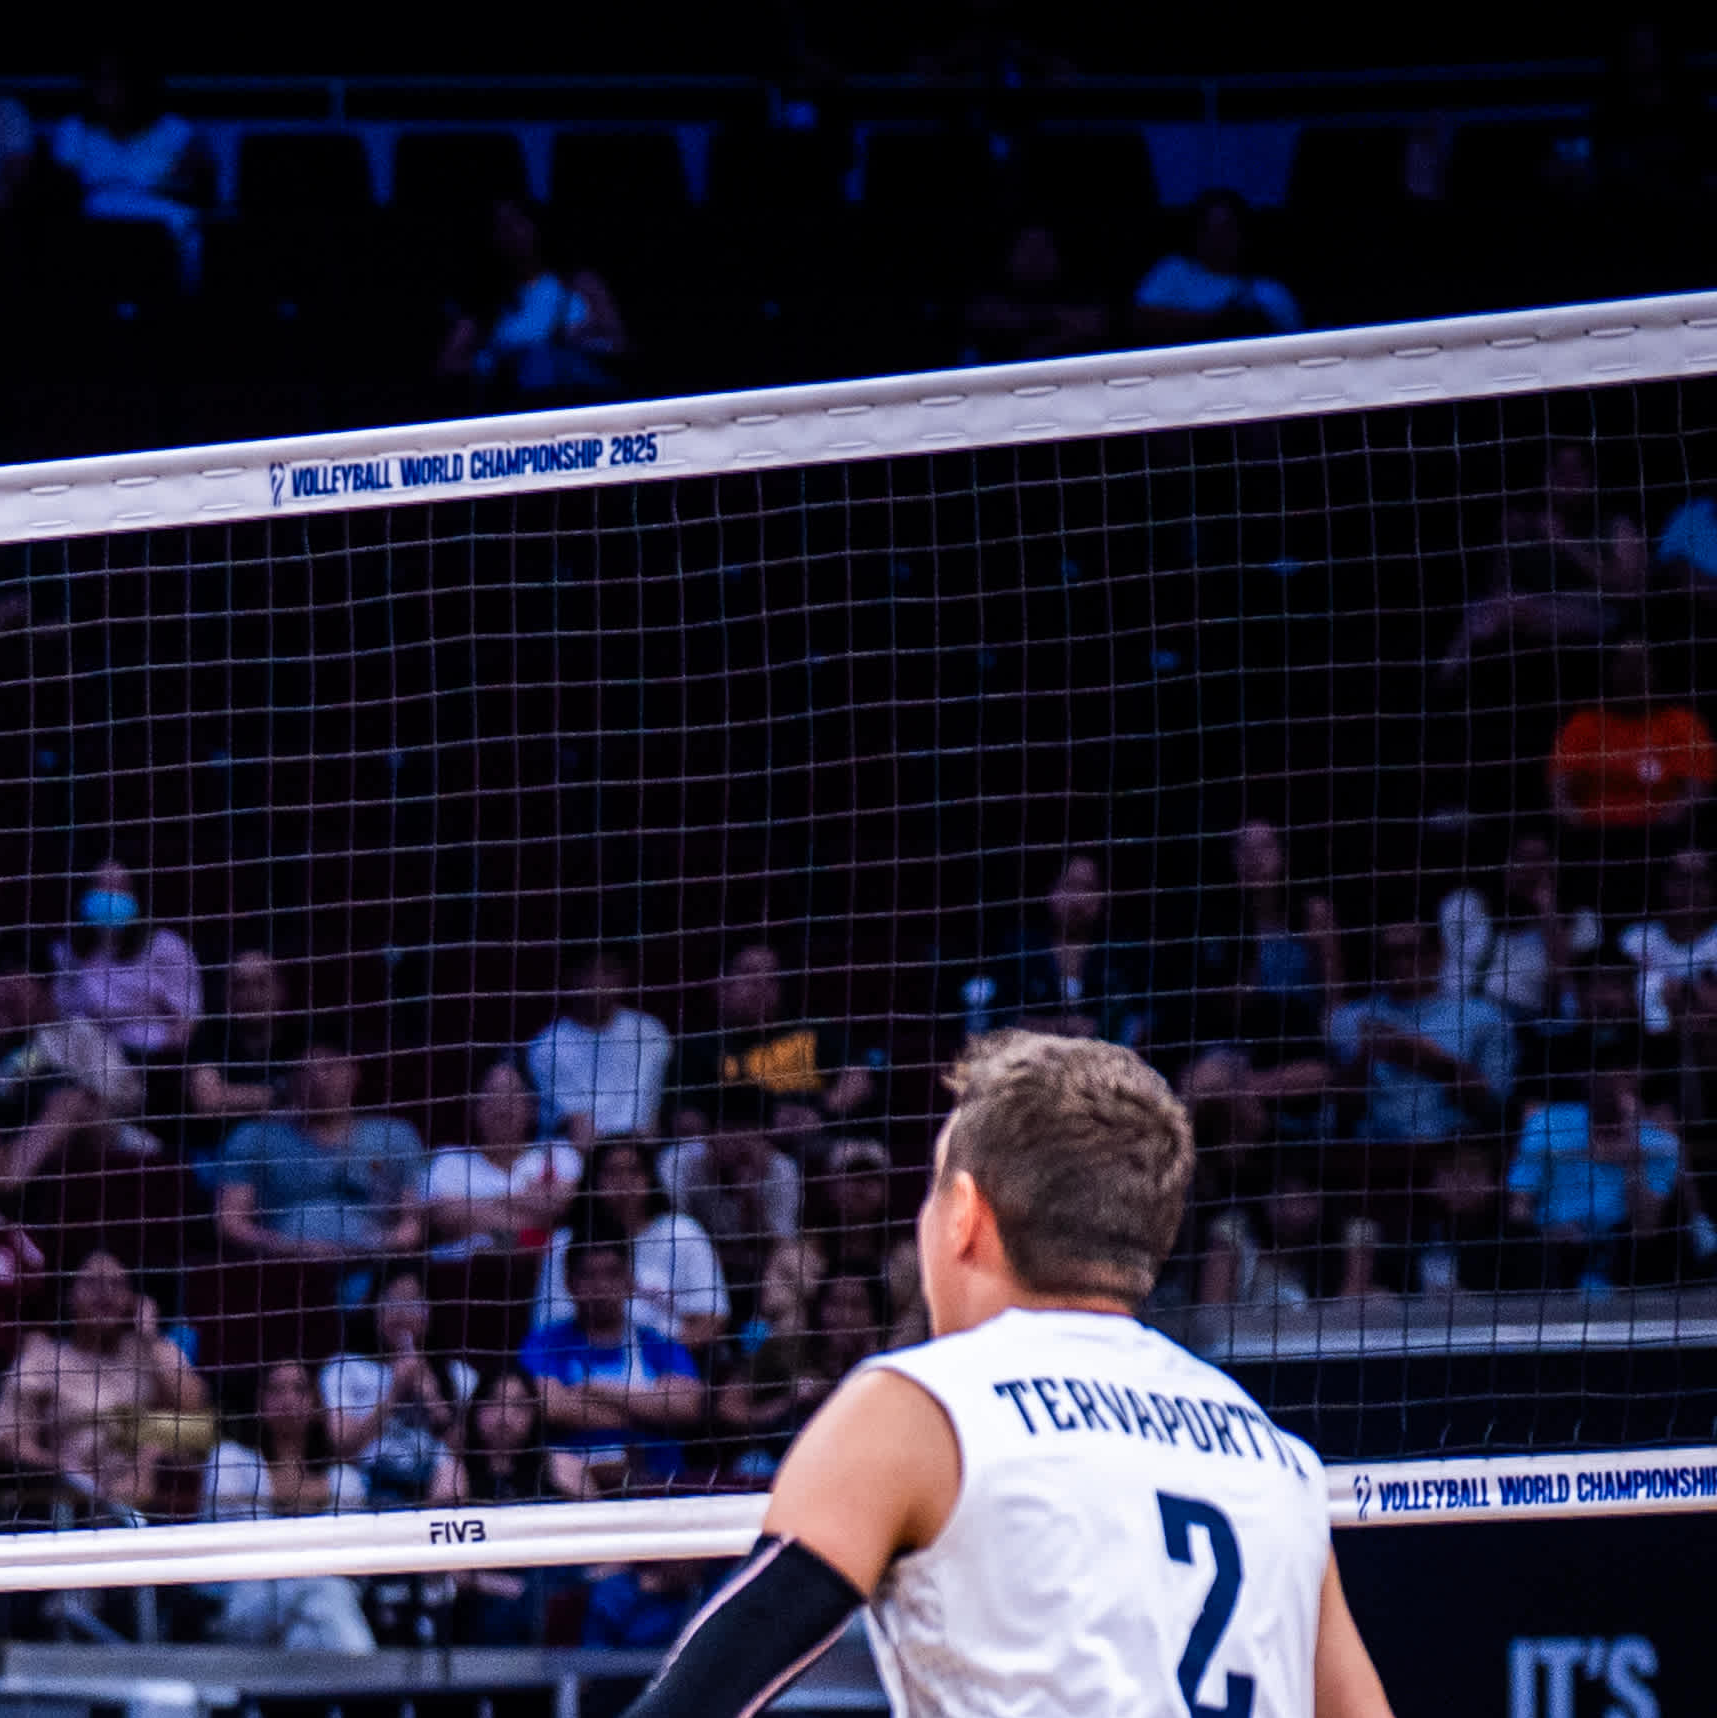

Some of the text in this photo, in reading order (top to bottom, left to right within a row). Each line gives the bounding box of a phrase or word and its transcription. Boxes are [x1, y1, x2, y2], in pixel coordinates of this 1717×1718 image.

[291, 459, 392, 497] VOLLEYBALL
[399, 453, 464, 487] WORLD
[470, 439, 603, 480] CHAMPIONSHIP
[1378, 1476, 1491, 1513] VOLLEYBALL
[1496, 1472, 1571, 1507] WORLD
